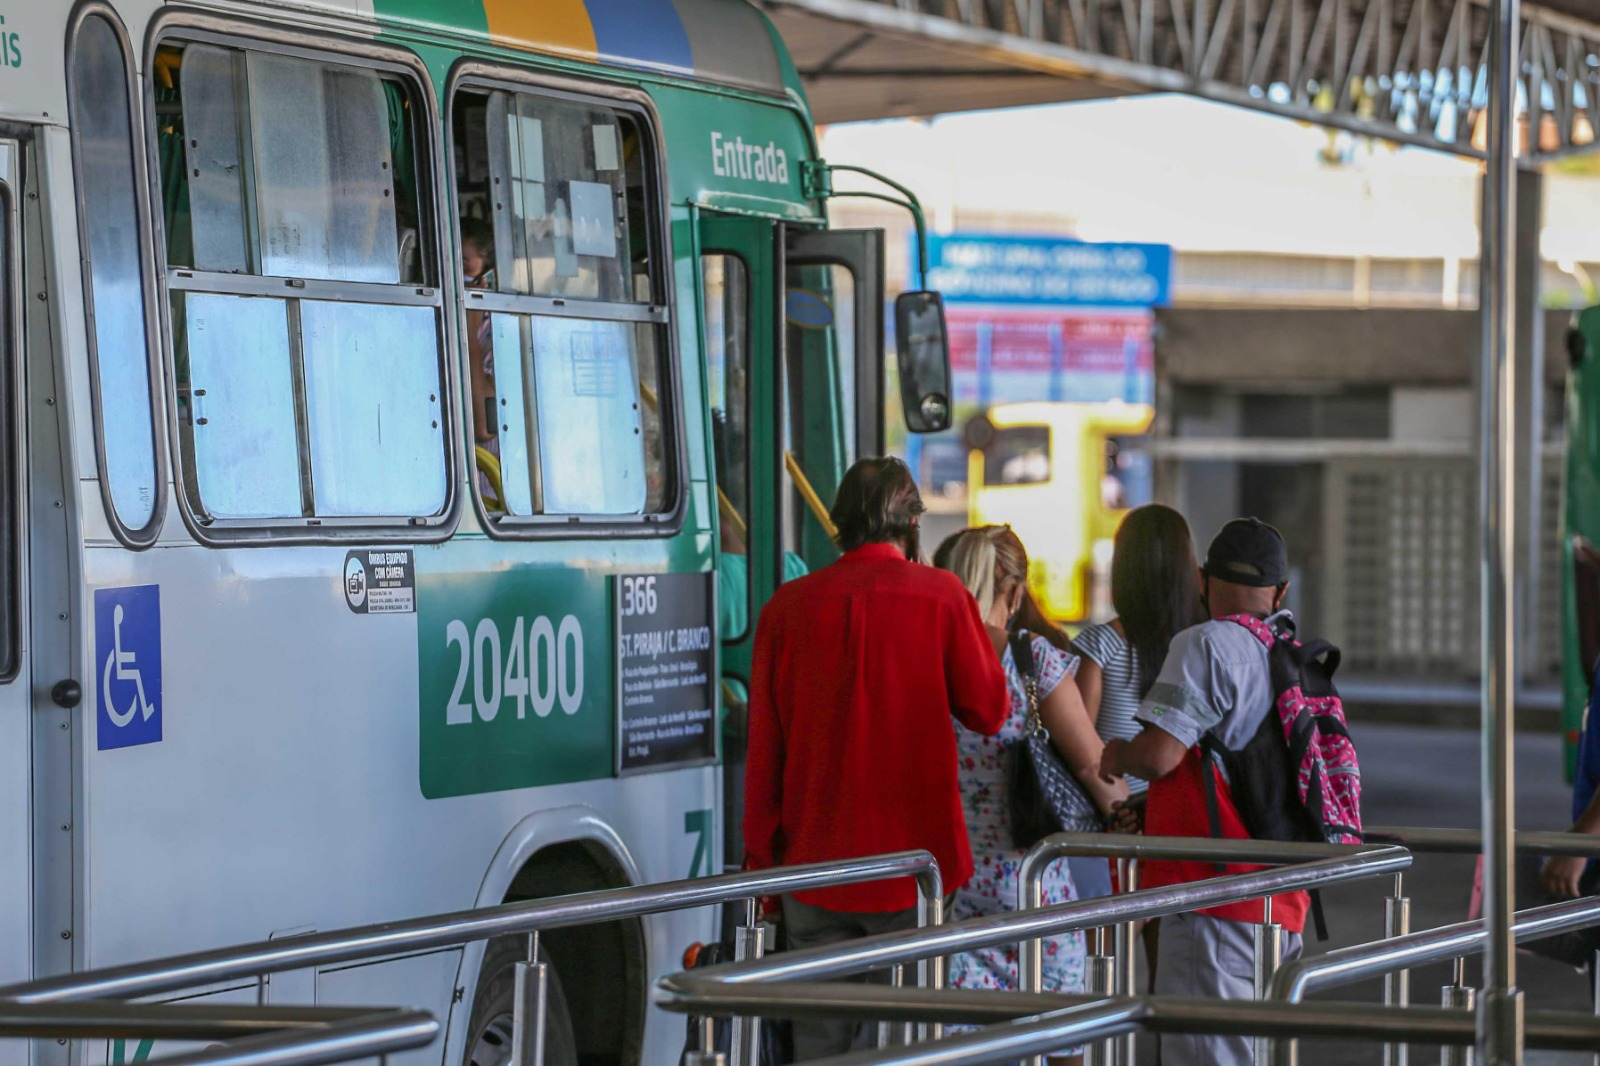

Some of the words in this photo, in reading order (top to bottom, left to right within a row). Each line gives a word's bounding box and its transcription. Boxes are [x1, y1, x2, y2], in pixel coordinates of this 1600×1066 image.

[0, 15, 22, 68] is
[710, 131, 789, 184] Entrada
[374, 567, 385, 579] COM
[620, 575, 657, 616] 366
[677, 626, 710, 652] BRANCO
[446, 614, 584, 726] 20400
